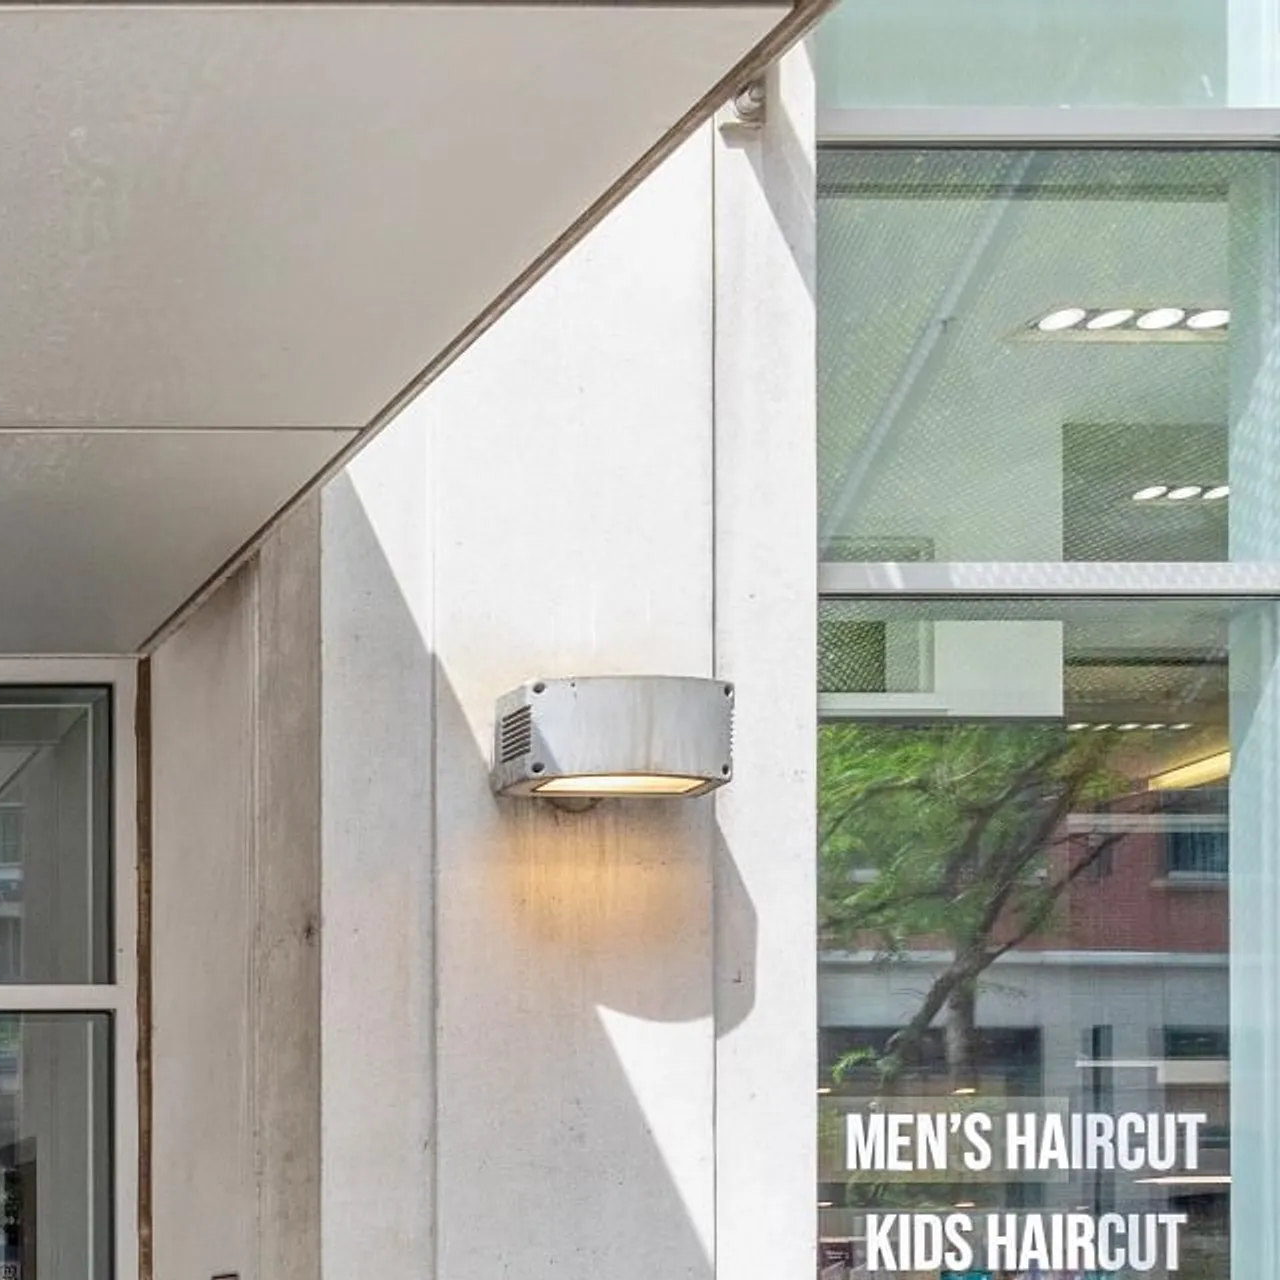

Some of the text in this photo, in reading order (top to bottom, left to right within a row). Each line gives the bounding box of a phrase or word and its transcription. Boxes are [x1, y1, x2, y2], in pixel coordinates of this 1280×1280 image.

[846, 1112, 1207, 1170] MEN'S HAIRCUT
[866, 1213, 1187, 1272] KIDS HAIRCUT
